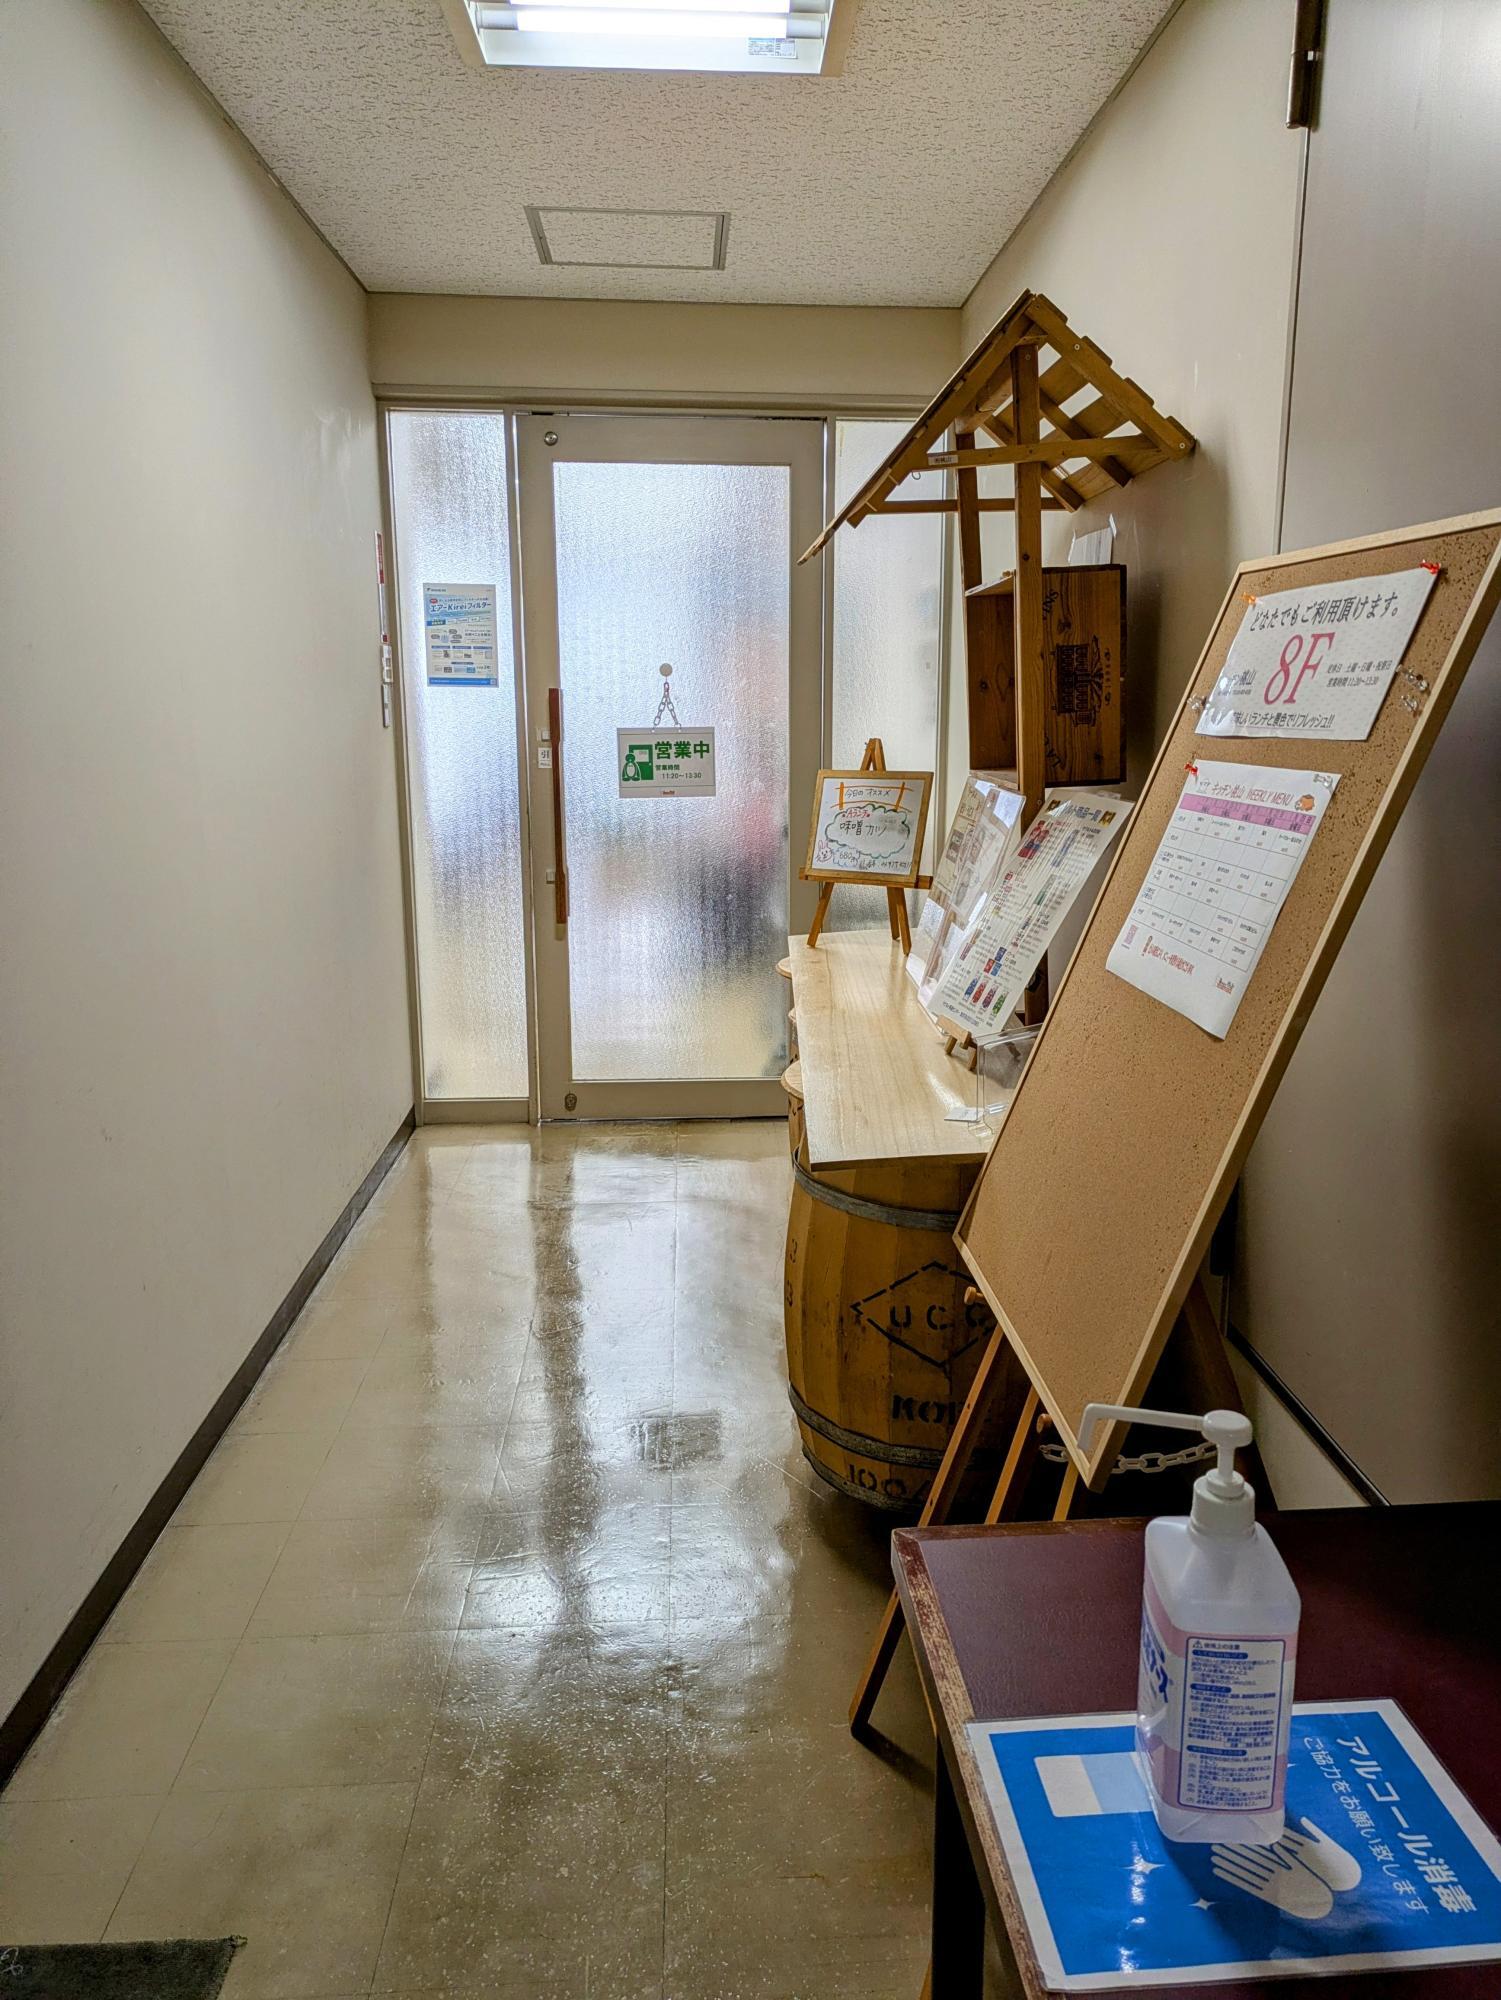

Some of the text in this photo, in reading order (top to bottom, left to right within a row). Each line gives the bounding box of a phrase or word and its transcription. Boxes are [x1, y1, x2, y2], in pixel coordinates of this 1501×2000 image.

[1250, 592, 1398, 631] どなたでもご利用頂けます。
[1263, 632, 1336, 705] 8F
[654, 740, 710, 759] 営業中
[889, 1301, 988, 1331] UCC
[1303, 1736, 1430, 1915] ご協力をお願い致します
[1336, 1735, 1477, 1913] アルコール消毒
